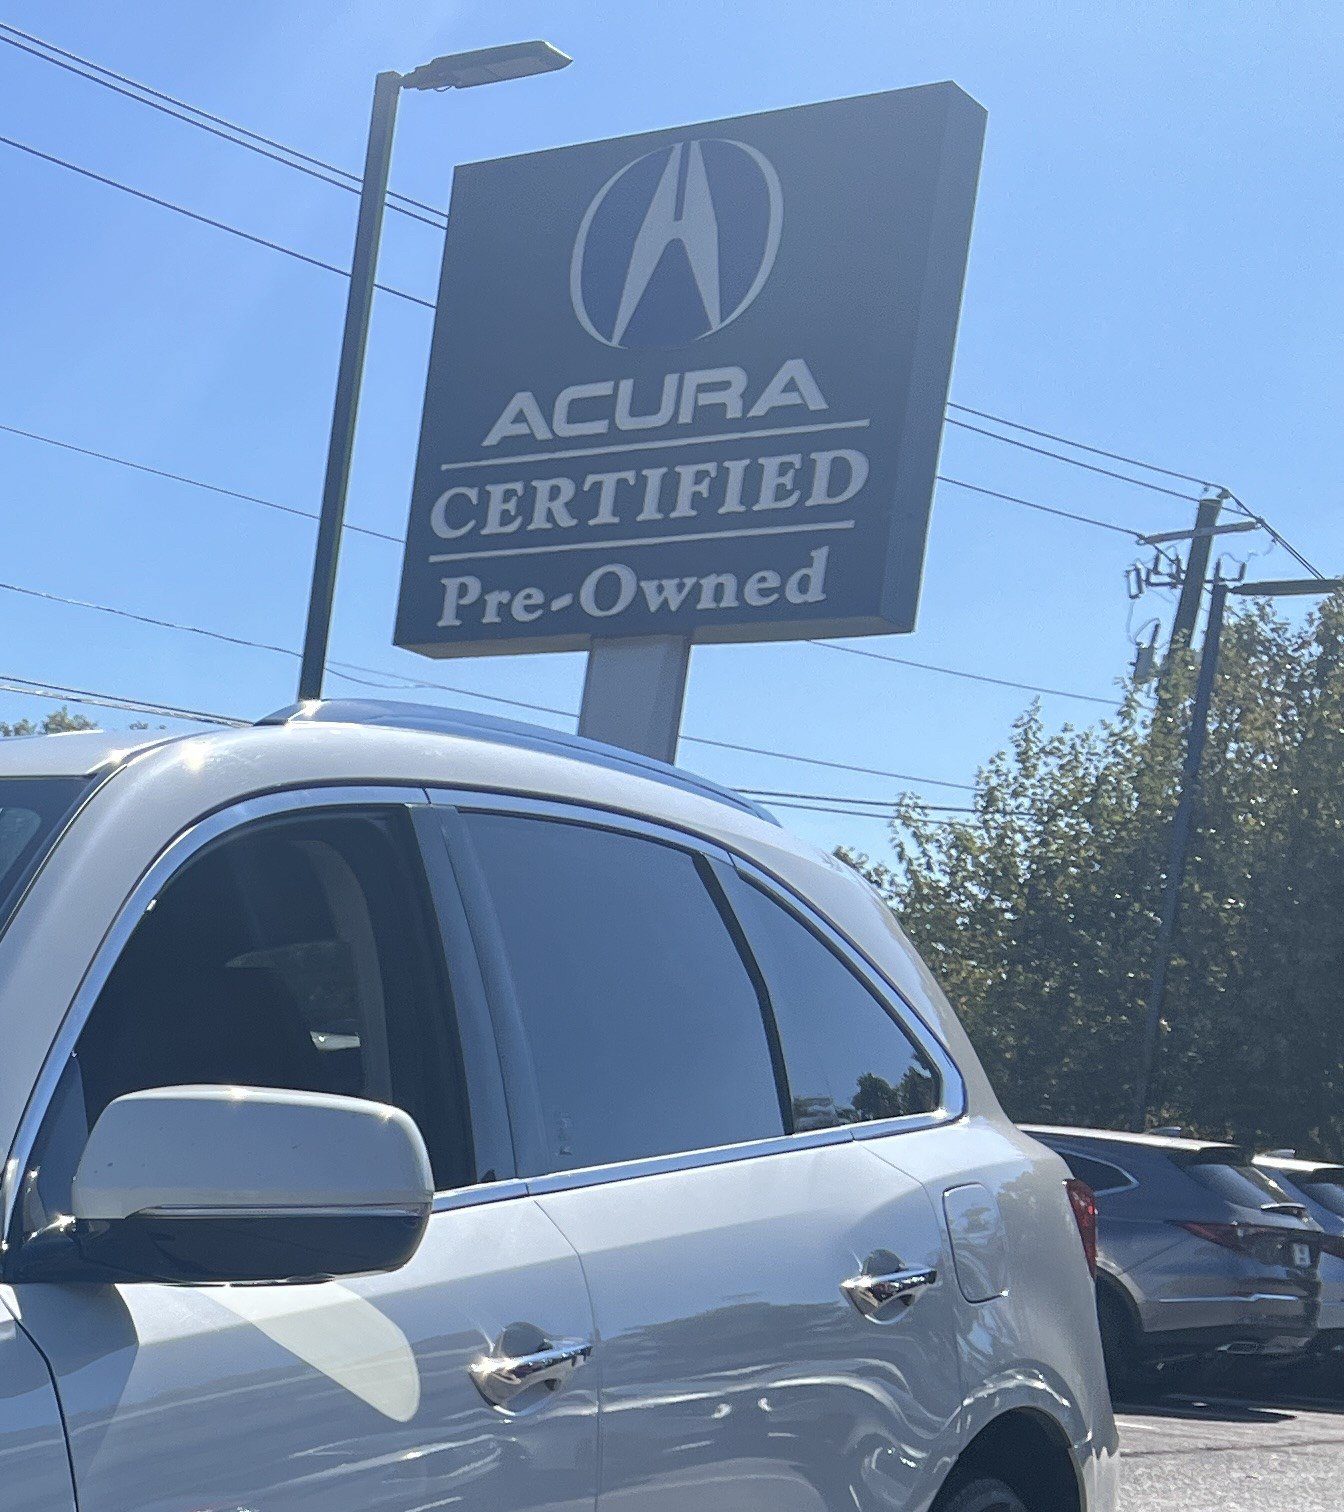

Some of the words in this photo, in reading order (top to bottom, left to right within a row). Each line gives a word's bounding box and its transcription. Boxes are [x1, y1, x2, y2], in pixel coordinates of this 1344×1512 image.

[481, 358, 830, 446] ACURA
[429, 447, 871, 540] CERTIFIED
[436, 545, 830, 628] Pre-Owned
